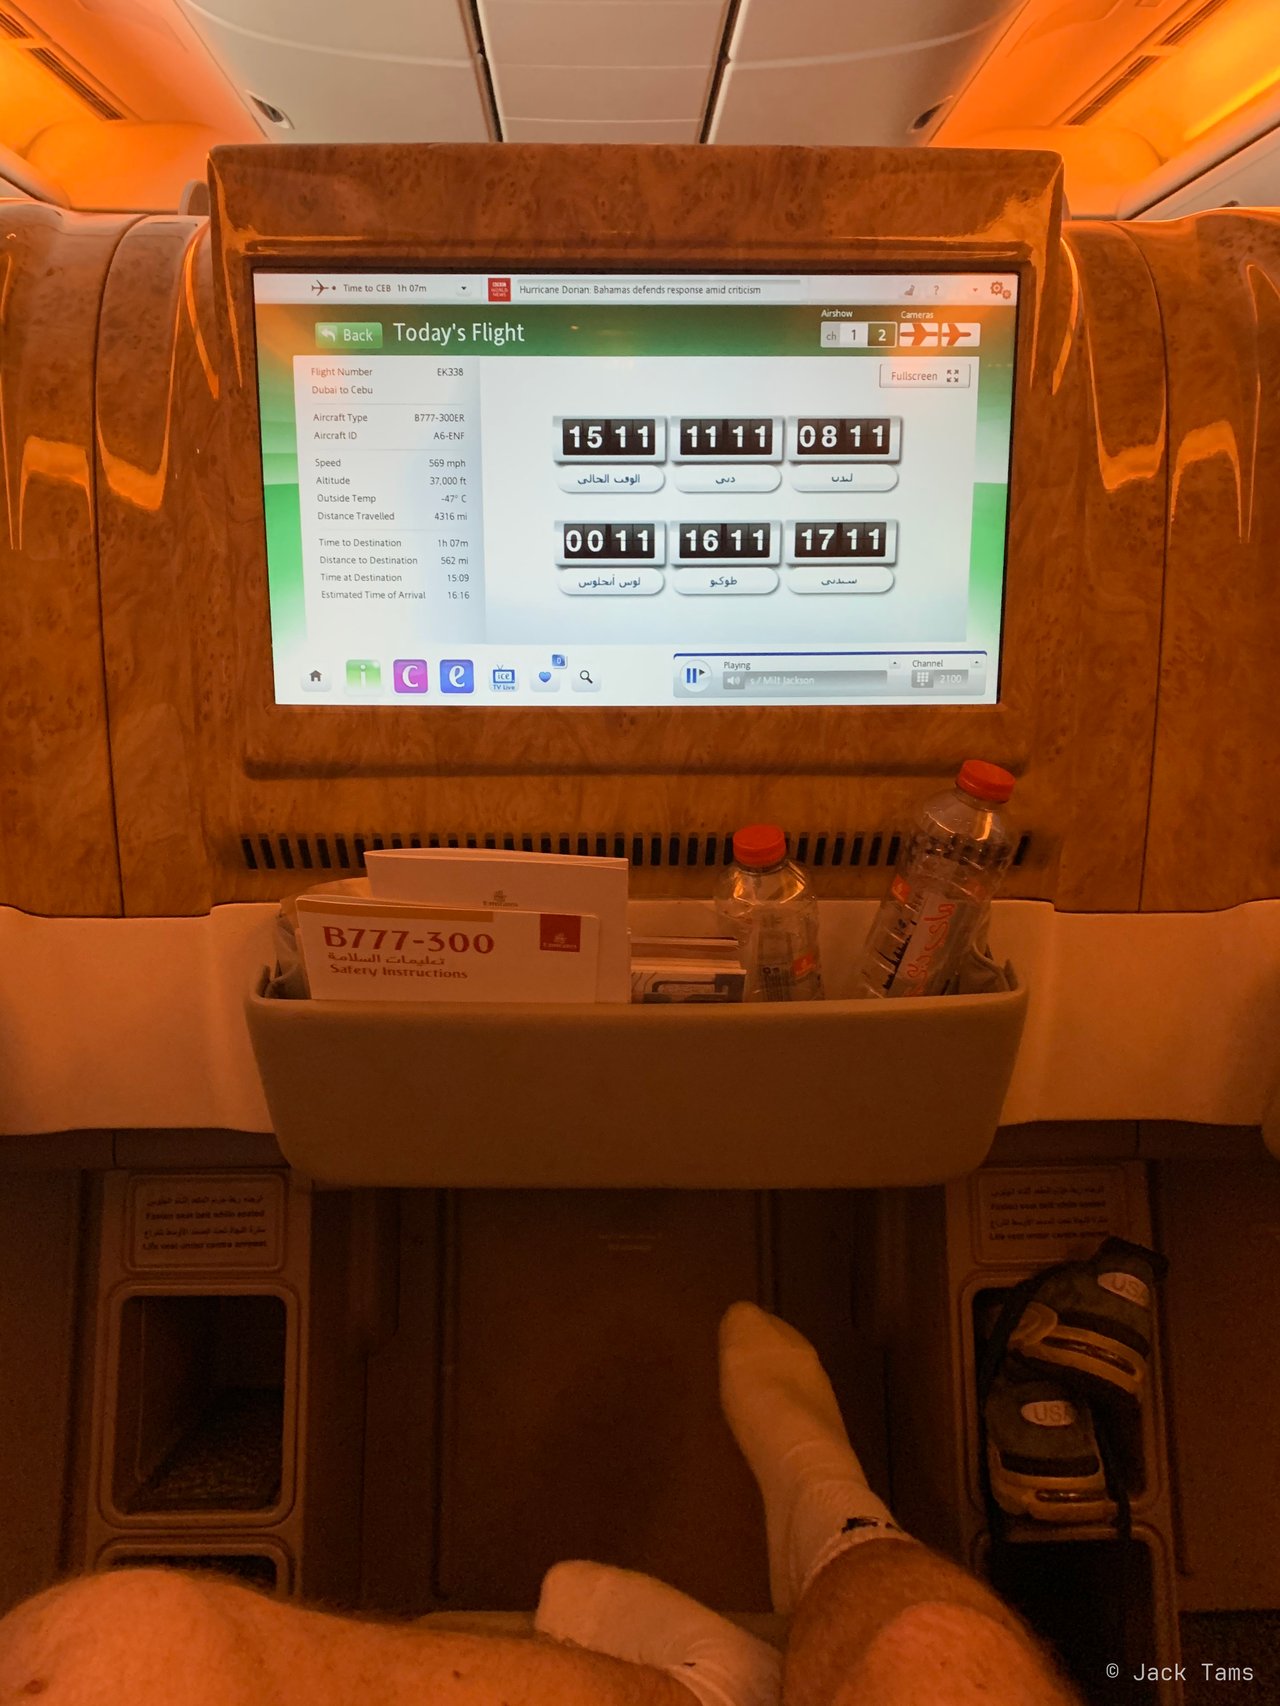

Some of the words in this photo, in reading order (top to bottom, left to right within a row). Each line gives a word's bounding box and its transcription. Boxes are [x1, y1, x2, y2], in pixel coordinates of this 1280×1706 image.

[343, 284, 362, 293] Time
[365, 284, 374, 293] to
[376, 283, 391, 293] CEB
[397, 283, 408, 293] 1h
[409, 283, 427, 293] 07m
[520, 285, 559, 294] Hurricane
[562, 285, 591, 294] Dorian:
[594, 285, 630, 294] Bahamas
[632, 285, 666, 295] defends
[667, 287, 704, 297] response
[705, 285, 726, 295] amid
[728, 285, 761, 295] criticism
[821, 310, 853, 318] Airshow
[901, 311, 934, 319] Cameras
[343, 328, 373, 342] Back
[392, 322, 466, 346] Today's
[472, 322, 525, 346] Flight
[826, 330, 837, 341] ch
[851, 330, 857, 341] 1
[878, 329, 887, 341] 2
[311, 367, 335, 378] Flight
[337, 367, 373, 376] Number
[437, 368, 464, 377] EK338
[891, 371, 938, 381] Fullscreen
[312, 385, 337, 395] Dubai
[339, 386, 349, 394] to
[351, 385, 374, 395] Cebu
[313, 413, 346, 422] Aircraft
[347, 413, 369, 423] Type
[414, 413, 465, 422] B777-300ER
[314, 431, 347, 440] Aircraft
[348, 431, 358, 440] ID
[433, 431, 465, 440] A6-ENF
[315, 458, 342, 469] Speed
[428, 458, 445, 468] 569
[446, 458, 466, 469] mph
[316, 476, 351, 485] Altitude
[429, 477, 458, 486] 37,000
[459, 476, 467, 485] ft
[613, 474, 641, 486] الوقت
[317, 494, 351, 503] Outside
[352, 494, 377, 505] Temp
[461, 494, 467, 503] C
[317, 512, 354, 521] Distance
[356, 512, 395, 521] Travelled
[434, 512, 455, 521] 4316
[457, 512, 468, 521] mi
[319, 538, 340, 547] Time
[342, 539, 351, 547] to
[353, 538, 402, 547] Destination
[437, 539, 448, 548] 1h
[449, 539, 469, 548] 07m
[319, 556, 357, 565] Distance
[358, 557, 368, 565] to
[369, 556, 418, 565] Destination
[440, 556, 456, 565] 562
[458, 556, 469, 565] mi
[320, 573, 342, 582] Time
[343, 574, 352, 582] at
[354, 573, 402, 582] Destination
[447, 573, 470, 583] 15:09
[618, 576, 641, 588] لوس
[321, 590, 363, 599] Estimated
[365, 590, 386, 599] Time
[387, 590, 397, 599] of
[398, 590, 426, 599] Arrival
[447, 591, 470, 600] 16:16
[723, 661, 751, 671] Playing
[912, 659, 944, 668] Channel
[497, 672, 511, 680] ice
[783, 675, 815, 686] Jackson
[939, 674, 962, 684] 2100
[322, 925, 495, 954] B777-300
[328, 952, 381, 964] السلامة
[385, 955, 445, 967] تعليمات
[330, 964, 378, 978] Safety
[383, 966, 468, 979] Instructions
